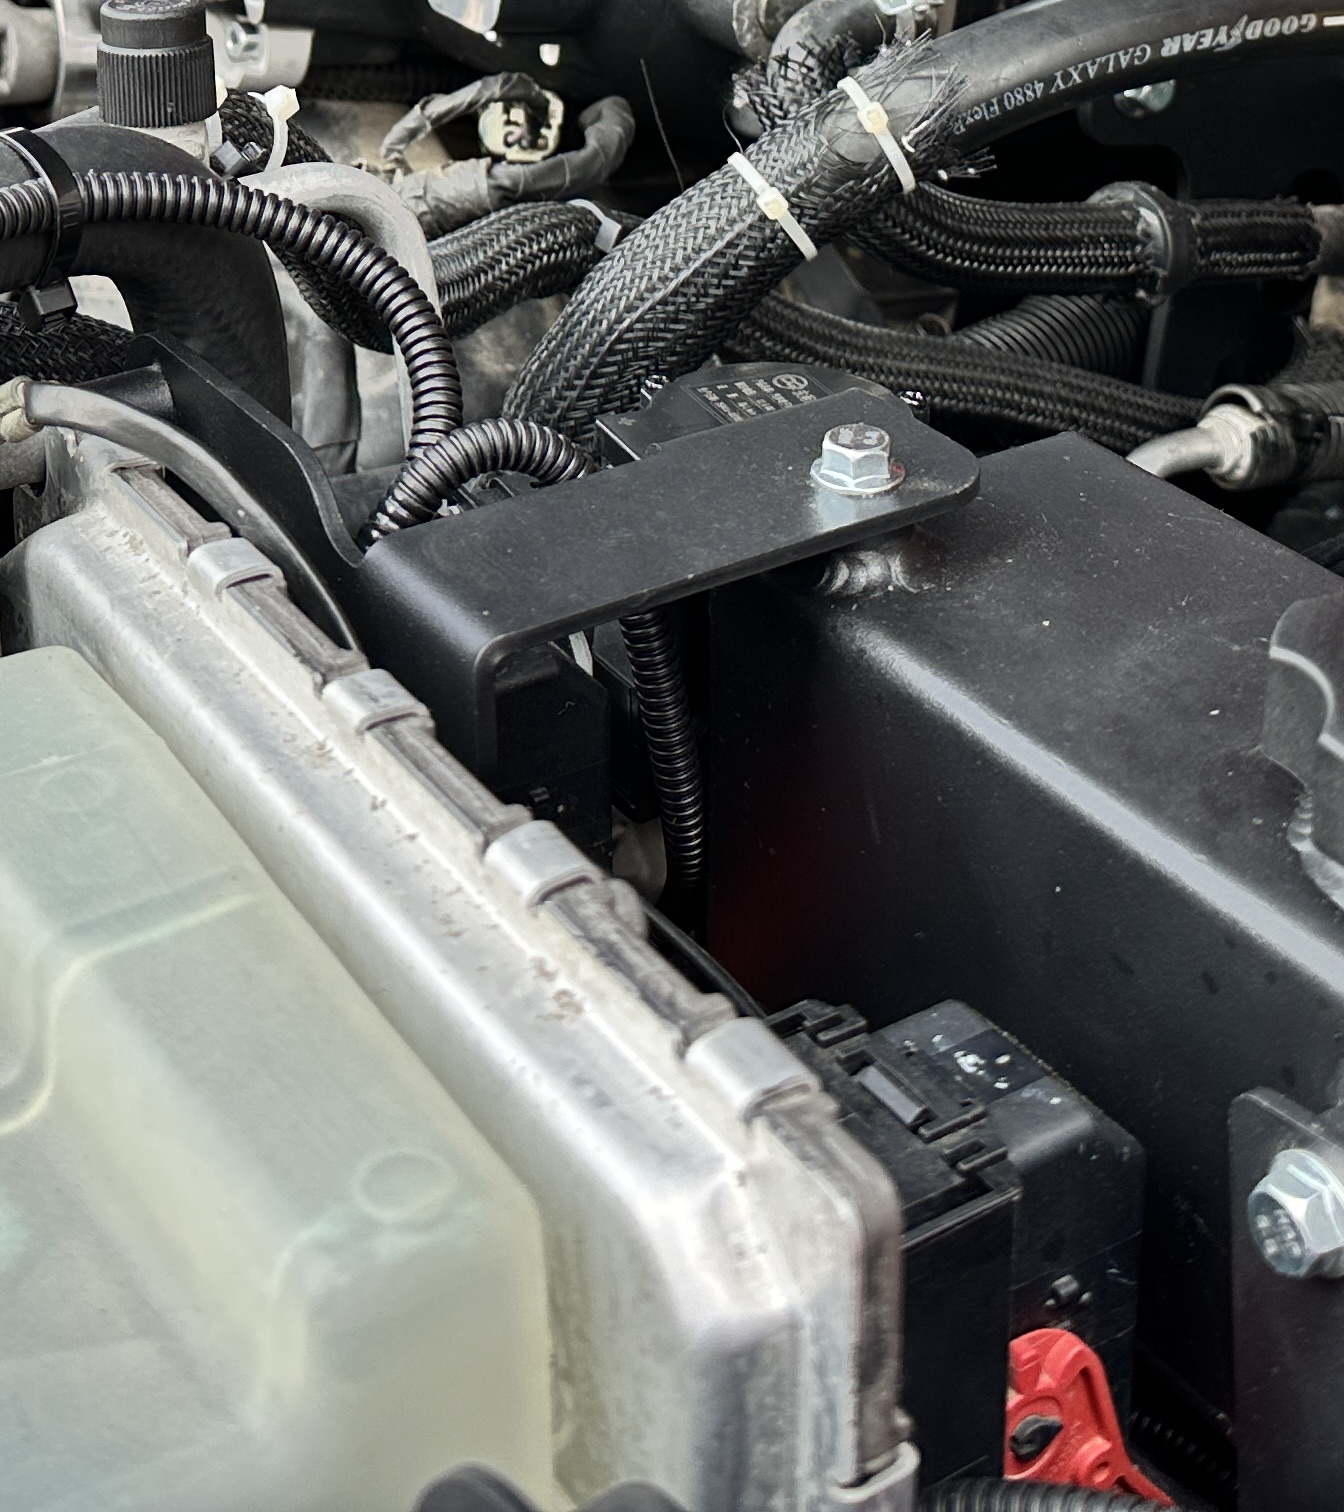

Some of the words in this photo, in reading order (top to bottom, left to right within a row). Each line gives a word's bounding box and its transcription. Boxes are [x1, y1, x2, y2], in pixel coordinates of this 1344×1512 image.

[1161, 12, 1317, 59] GOODYEAR
[1049, 42, 1152, 94] GALAXY
[1003, 71, 1046, 114] 4880
